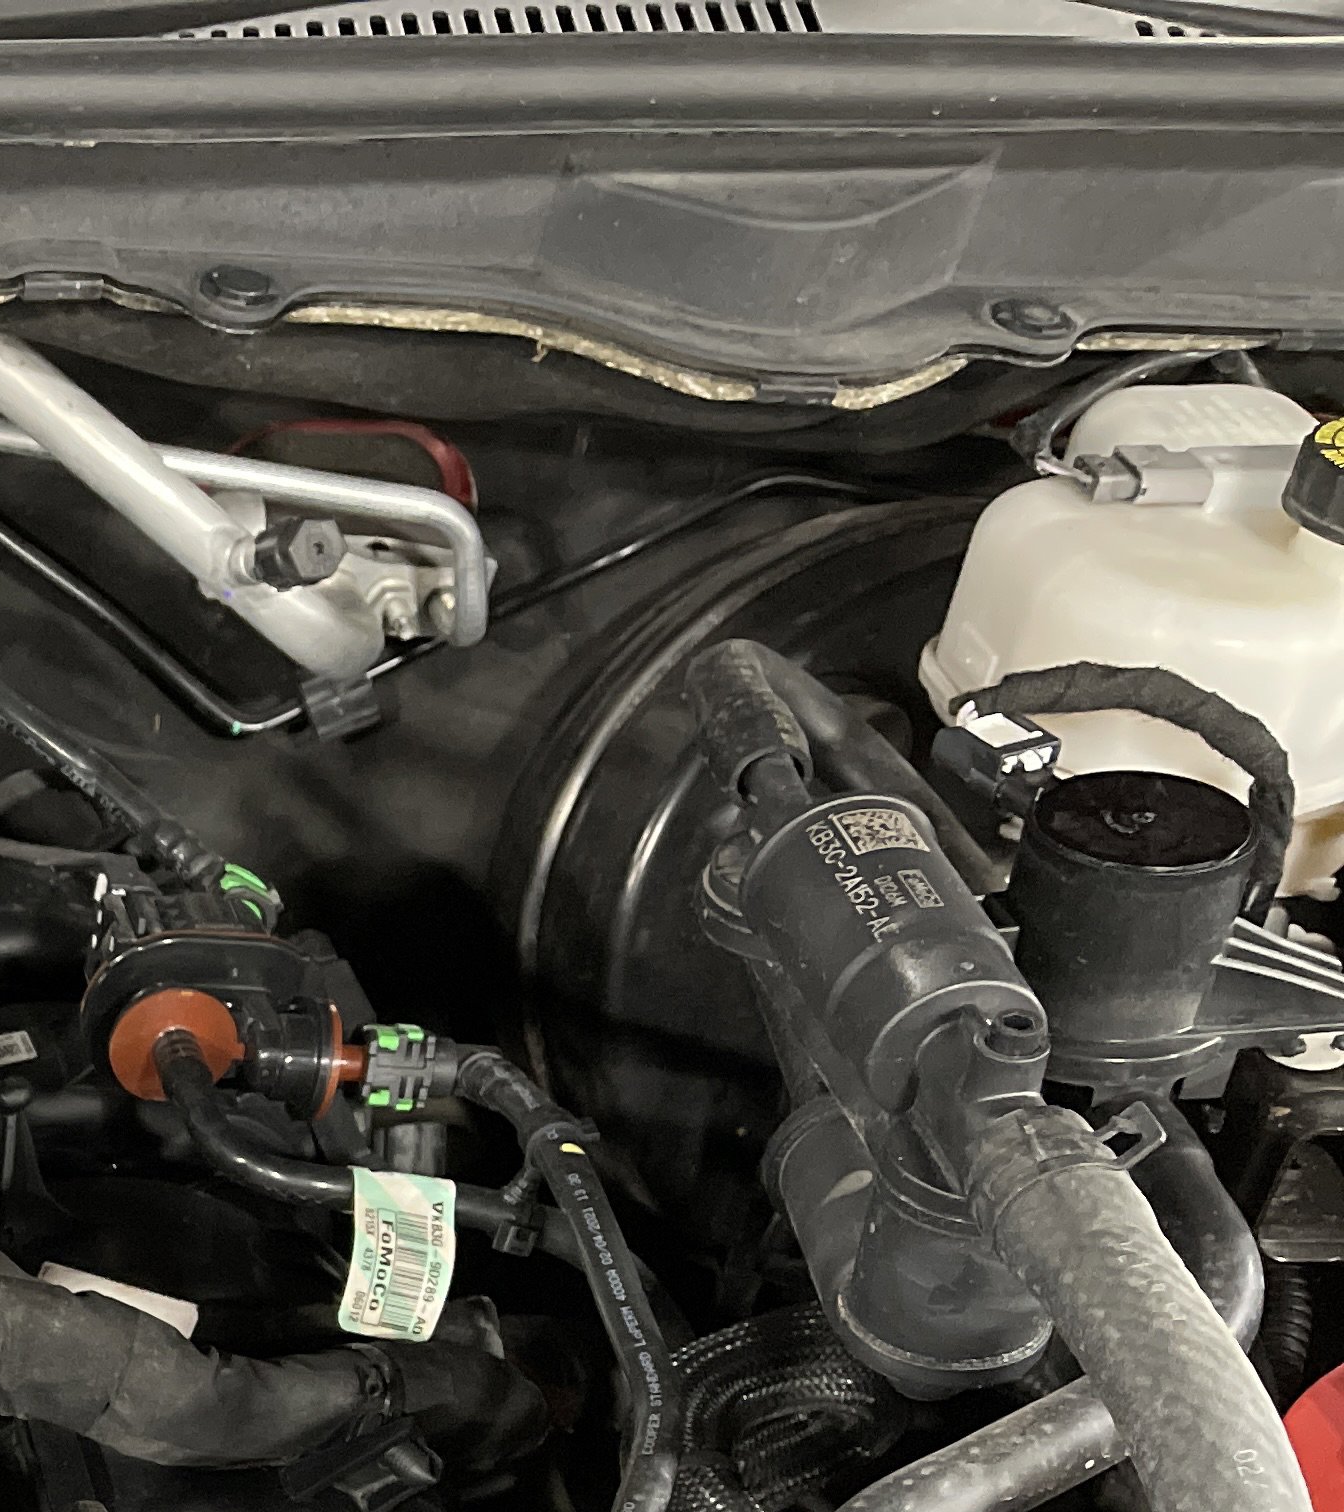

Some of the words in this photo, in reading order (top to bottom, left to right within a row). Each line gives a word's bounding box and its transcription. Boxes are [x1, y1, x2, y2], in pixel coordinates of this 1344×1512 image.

[368, 1219, 394, 1312] FoMoCo
[639, 1351, 662, 1406] STANDARD
[642, 1413, 661, 1455] COOPER
